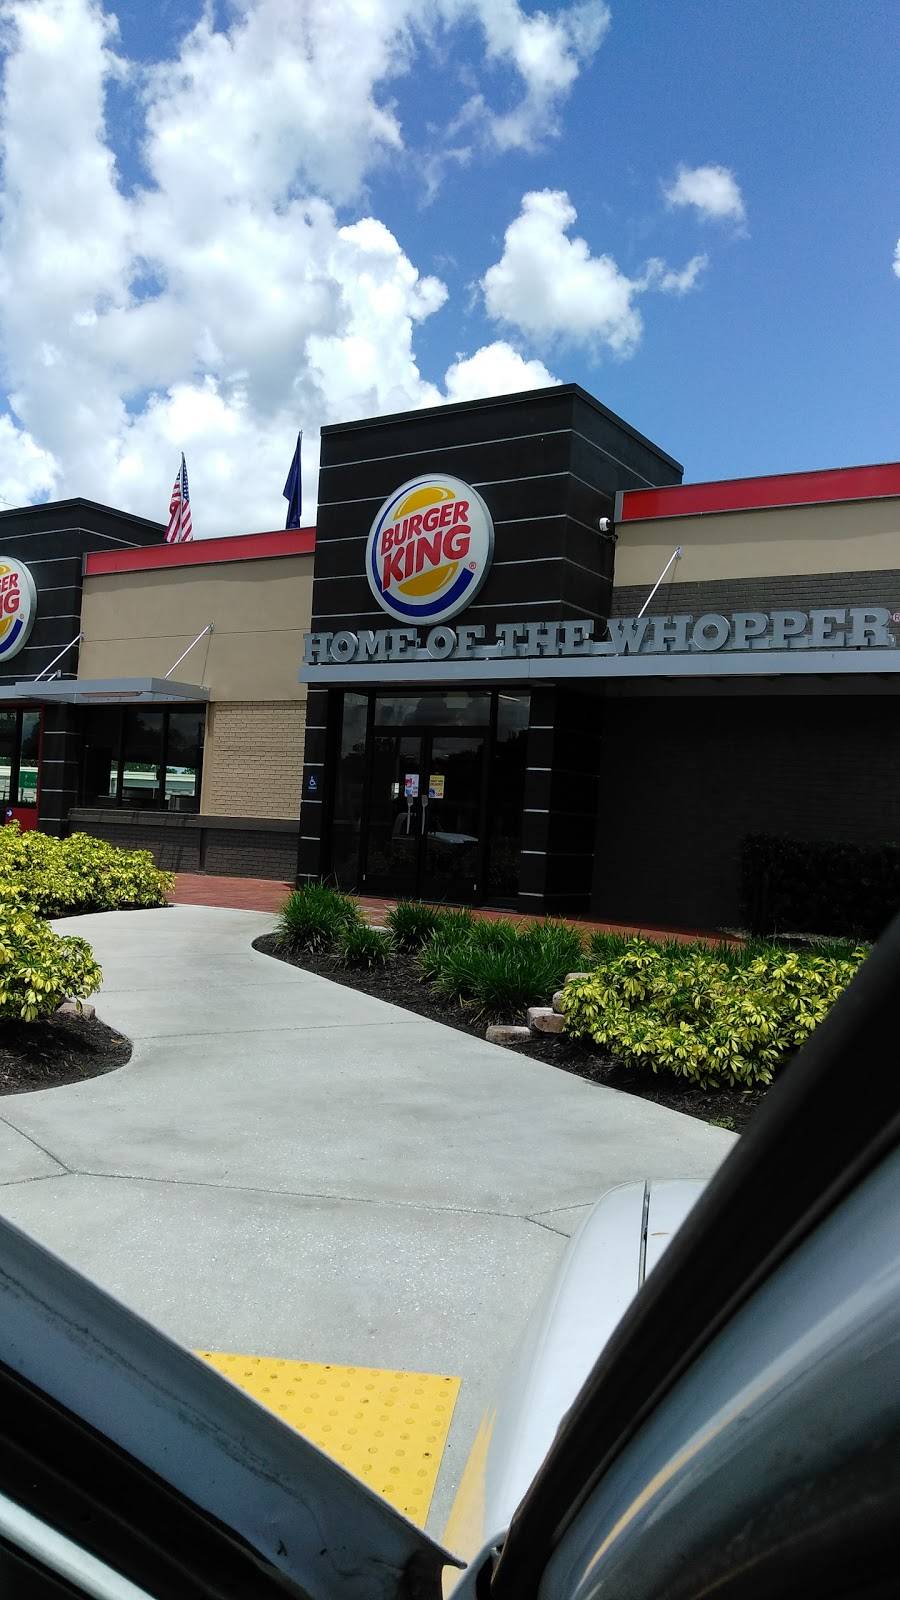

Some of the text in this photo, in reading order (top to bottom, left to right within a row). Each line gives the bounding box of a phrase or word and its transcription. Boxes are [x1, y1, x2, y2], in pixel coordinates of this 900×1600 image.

[380, 500, 470, 556] BURGER
[0, 573, 18, 593] ER
[381, 524, 472, 593] KING
[303, 608, 890, 663] HOME OF THE WHOPPER
